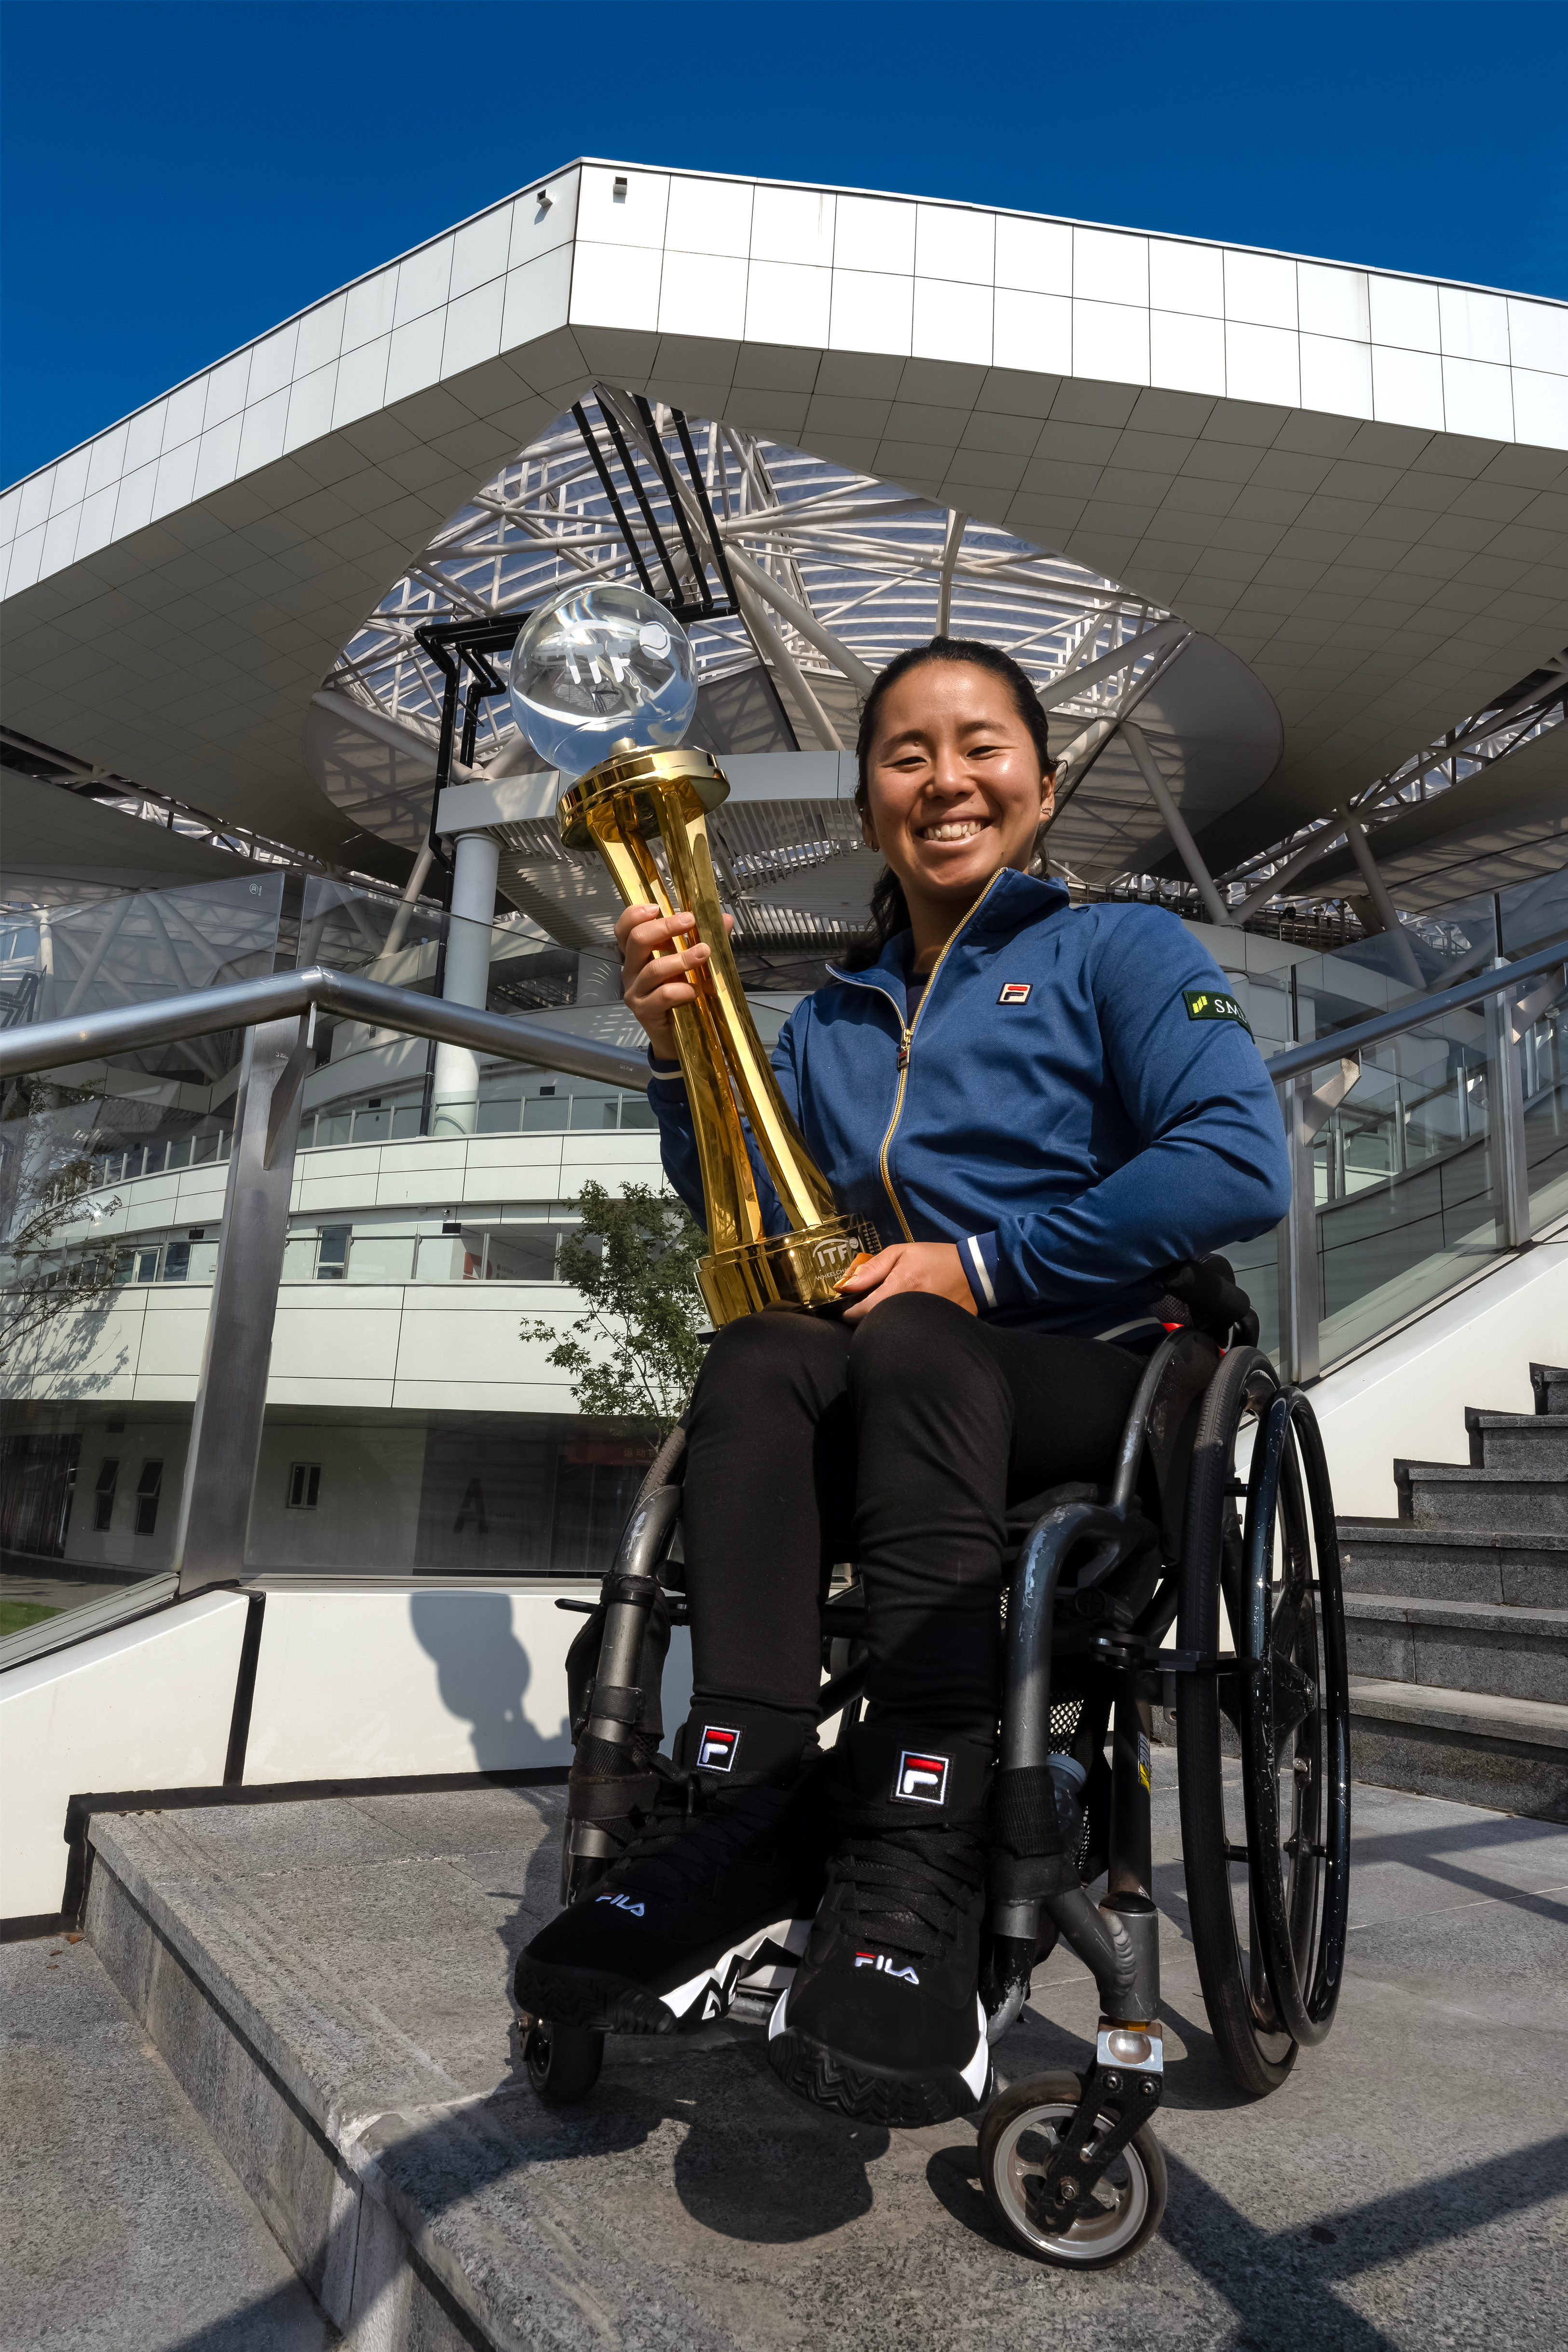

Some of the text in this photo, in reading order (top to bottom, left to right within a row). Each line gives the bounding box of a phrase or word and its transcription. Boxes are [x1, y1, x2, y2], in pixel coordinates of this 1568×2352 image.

[565, 641, 631, 684] ITF
[817, 1245, 847, 1267] ITF
[595, 1892, 645, 1917] FILA
[855, 1951, 919, 1985] FILA
